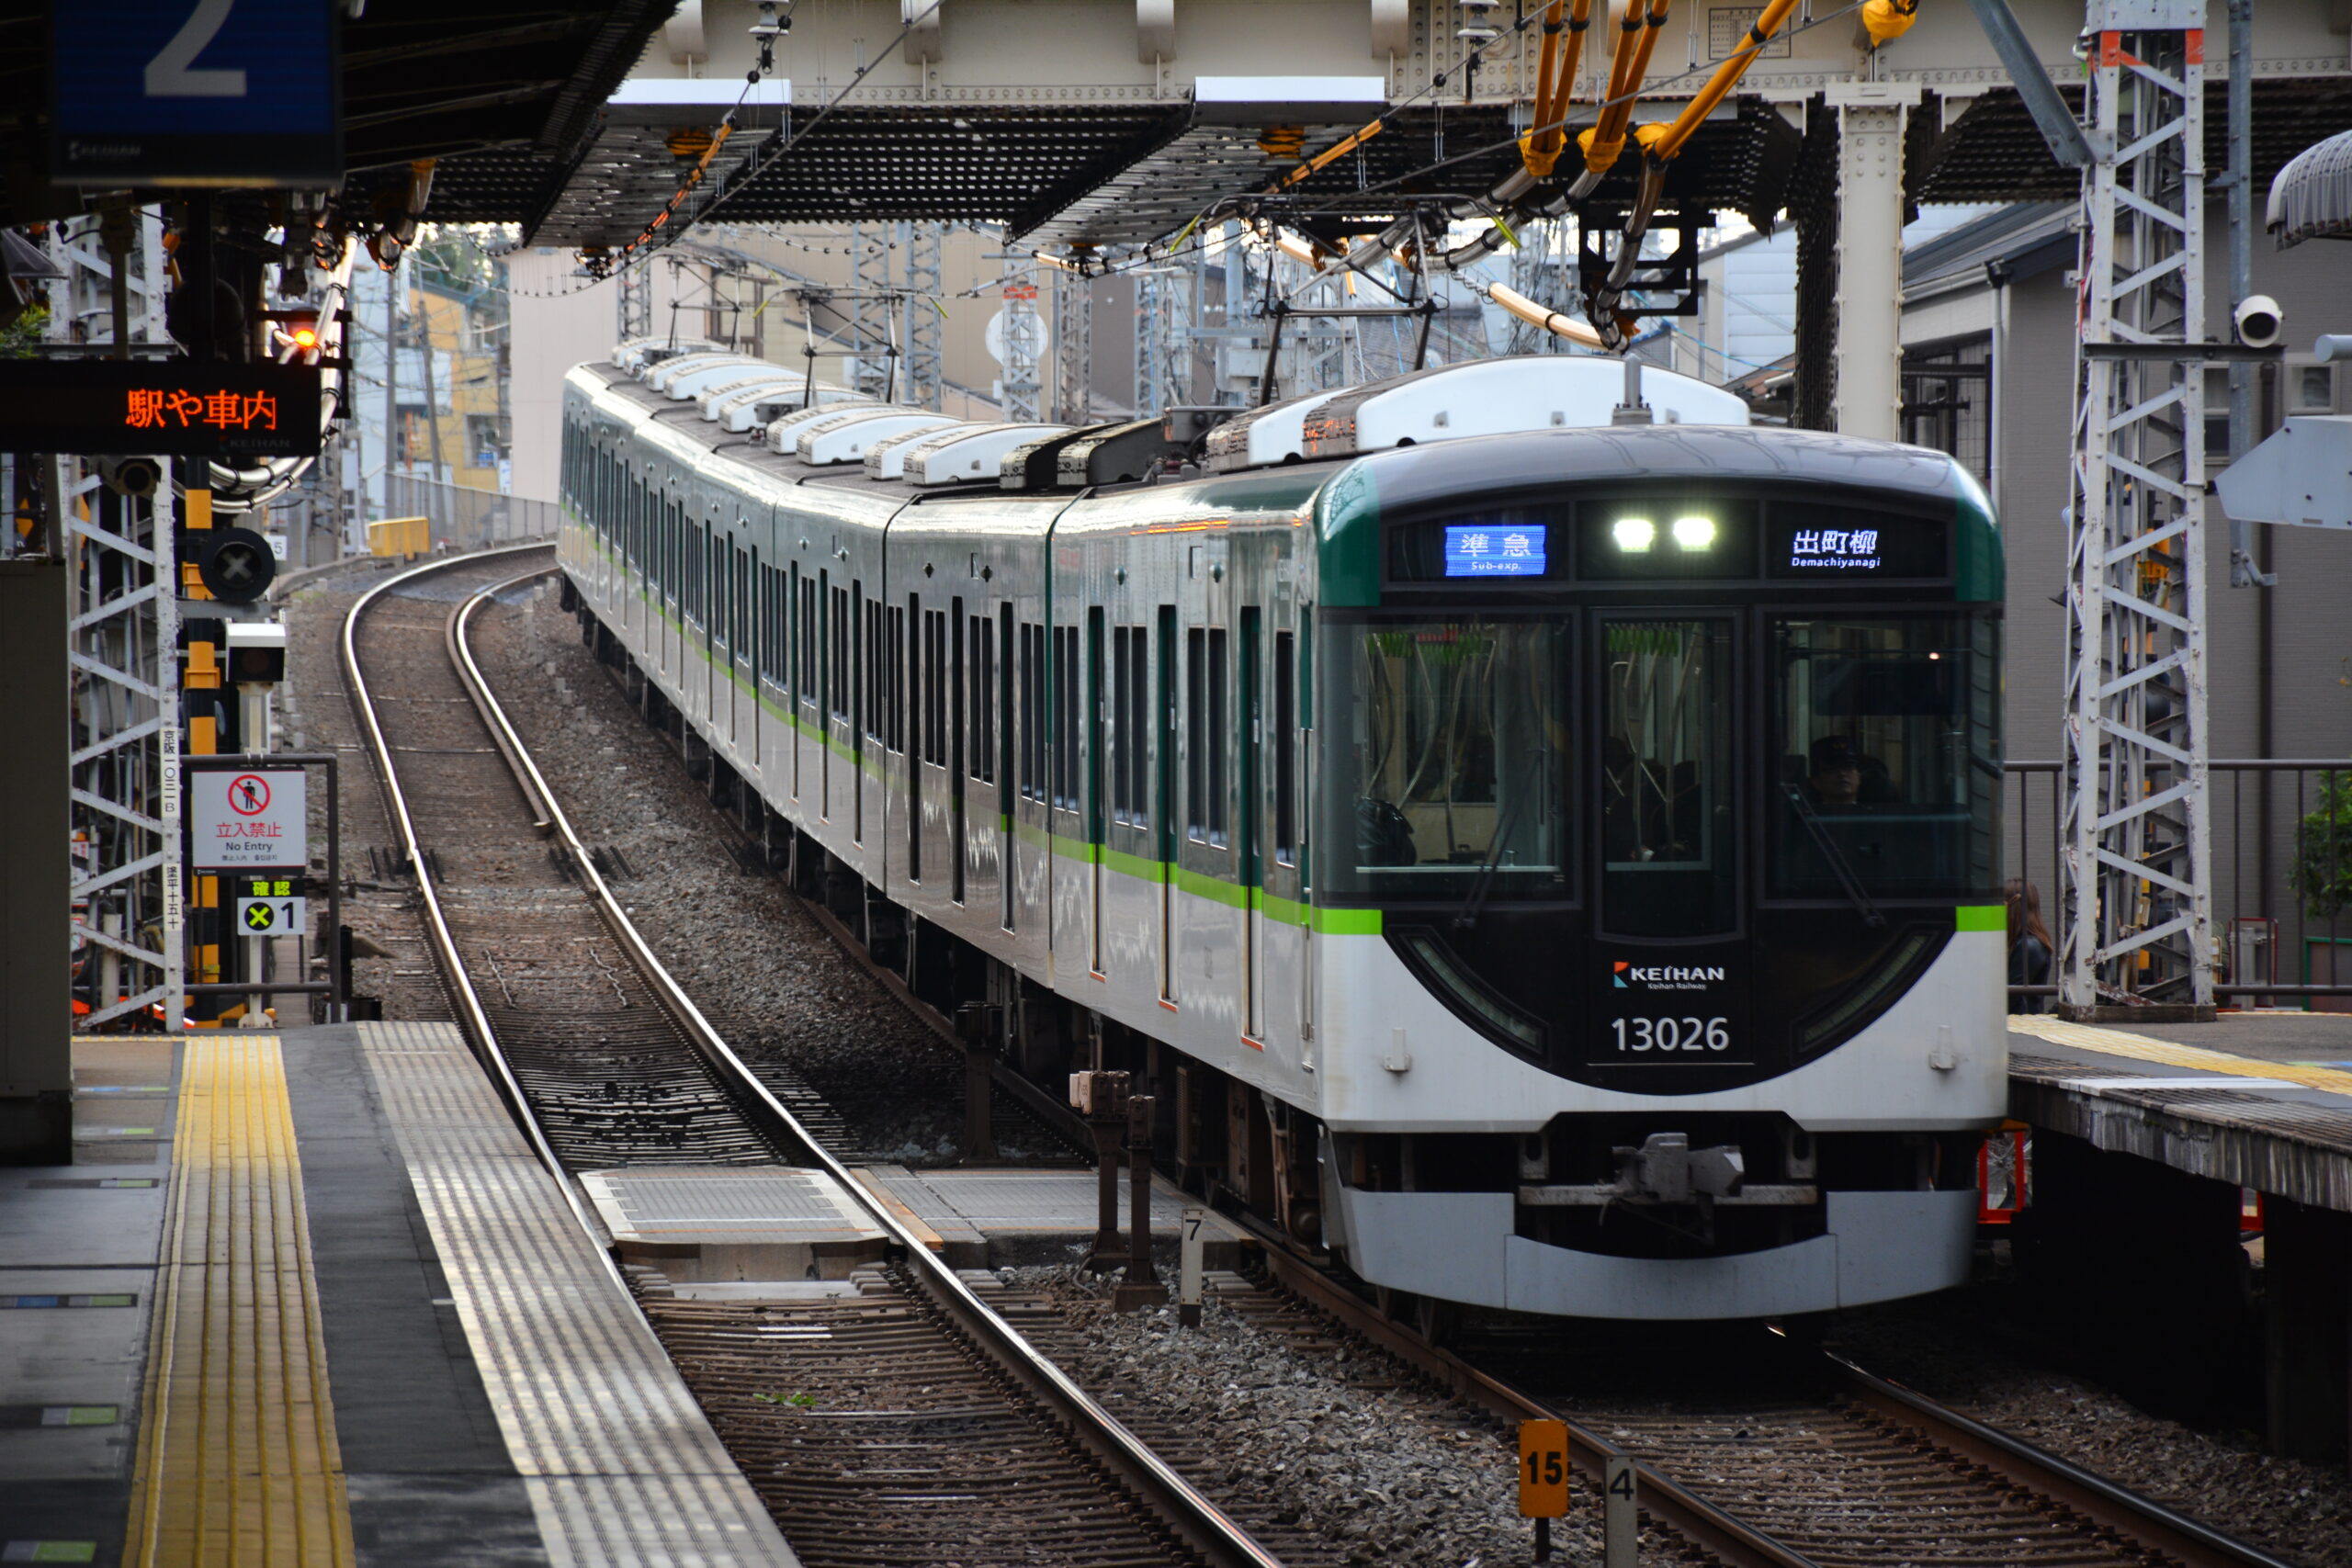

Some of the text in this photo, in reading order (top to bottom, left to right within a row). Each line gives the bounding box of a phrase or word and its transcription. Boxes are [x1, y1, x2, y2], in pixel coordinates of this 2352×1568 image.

[144, 0, 247, 96] 2
[126, 389, 277, 430] 駅や車内
[229, 438, 290, 448] KEIHAN
[1460, 533, 1532, 557] 準急
[1792, 529, 1878, 554] 出町柳
[1791, 557, 1881, 570] Demachiyanagi
[216, 821, 282, 838] 立入禁止
[226, 841, 273, 853] No Entry
[253, 881, 290, 897] 確認
[280, 901, 294, 930] 1
[1631, 965, 1725, 981] KEIHAN
[1647, 982, 1707, 990] Keihan Railway
[1611, 1016, 1730, 1052] 13026
[1185, 1219, 1202, 1241] 7
[1527, 1451, 1563, 1485] 15
[1609, 1468, 1634, 1501] 4
